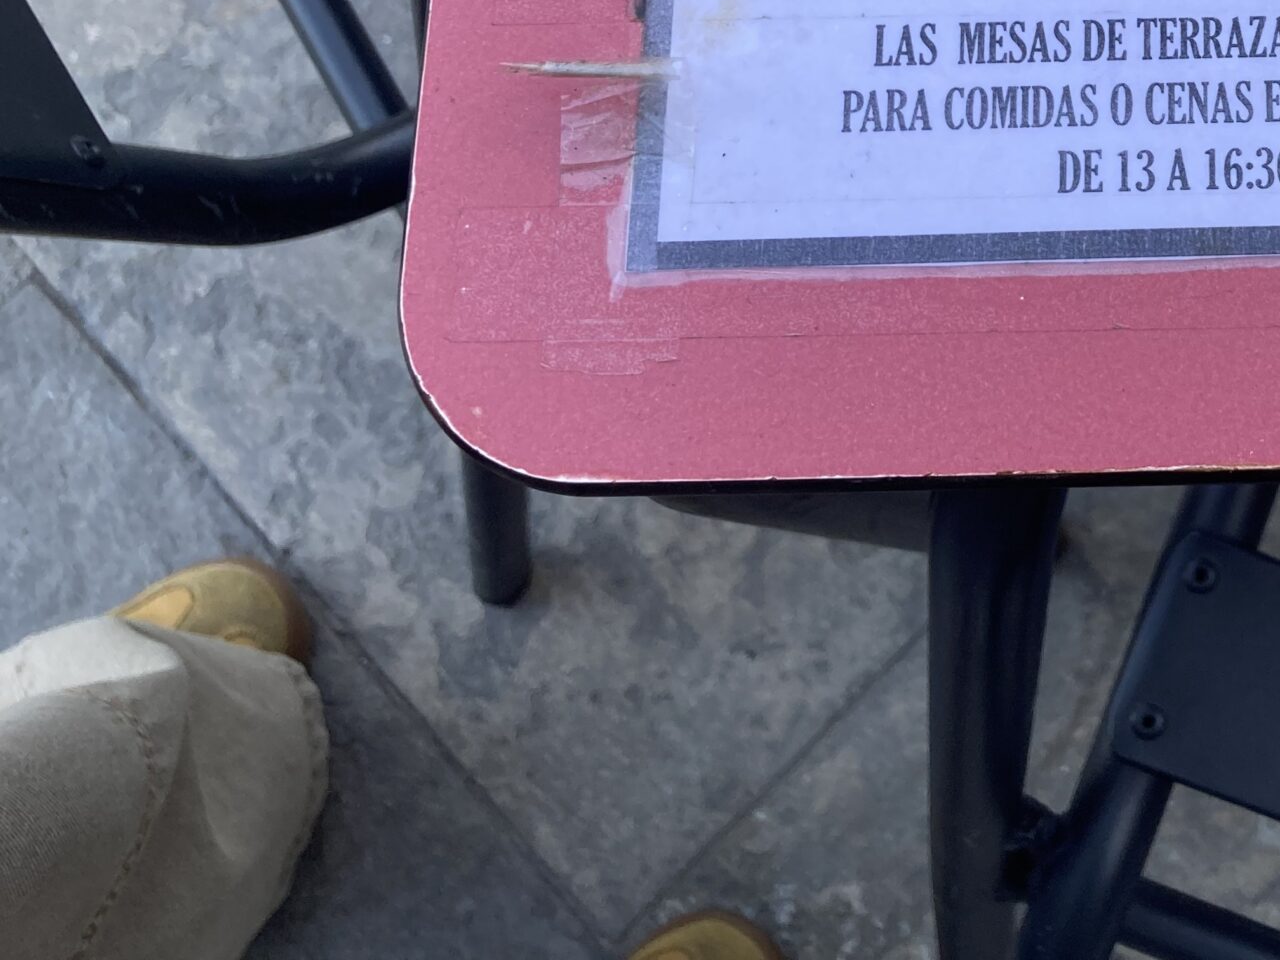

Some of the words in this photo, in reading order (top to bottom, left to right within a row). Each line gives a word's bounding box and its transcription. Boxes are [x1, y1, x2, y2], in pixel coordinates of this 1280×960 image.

[873, 22, 938, 67] LAS
[957, 19, 1072, 65] MESAS
[1082, 18, 1128, 62] DE
[840, 88, 933, 133] PARA
[943, 83, 1099, 131] COMIDAS
[1110, 82, 1134, 127] O
[1145, 80, 1254, 126] CENAS
[1057, 149, 1104, 194] DE
[1117, 149, 1156, 193] 13
[1166, 147, 1191, 192] A
